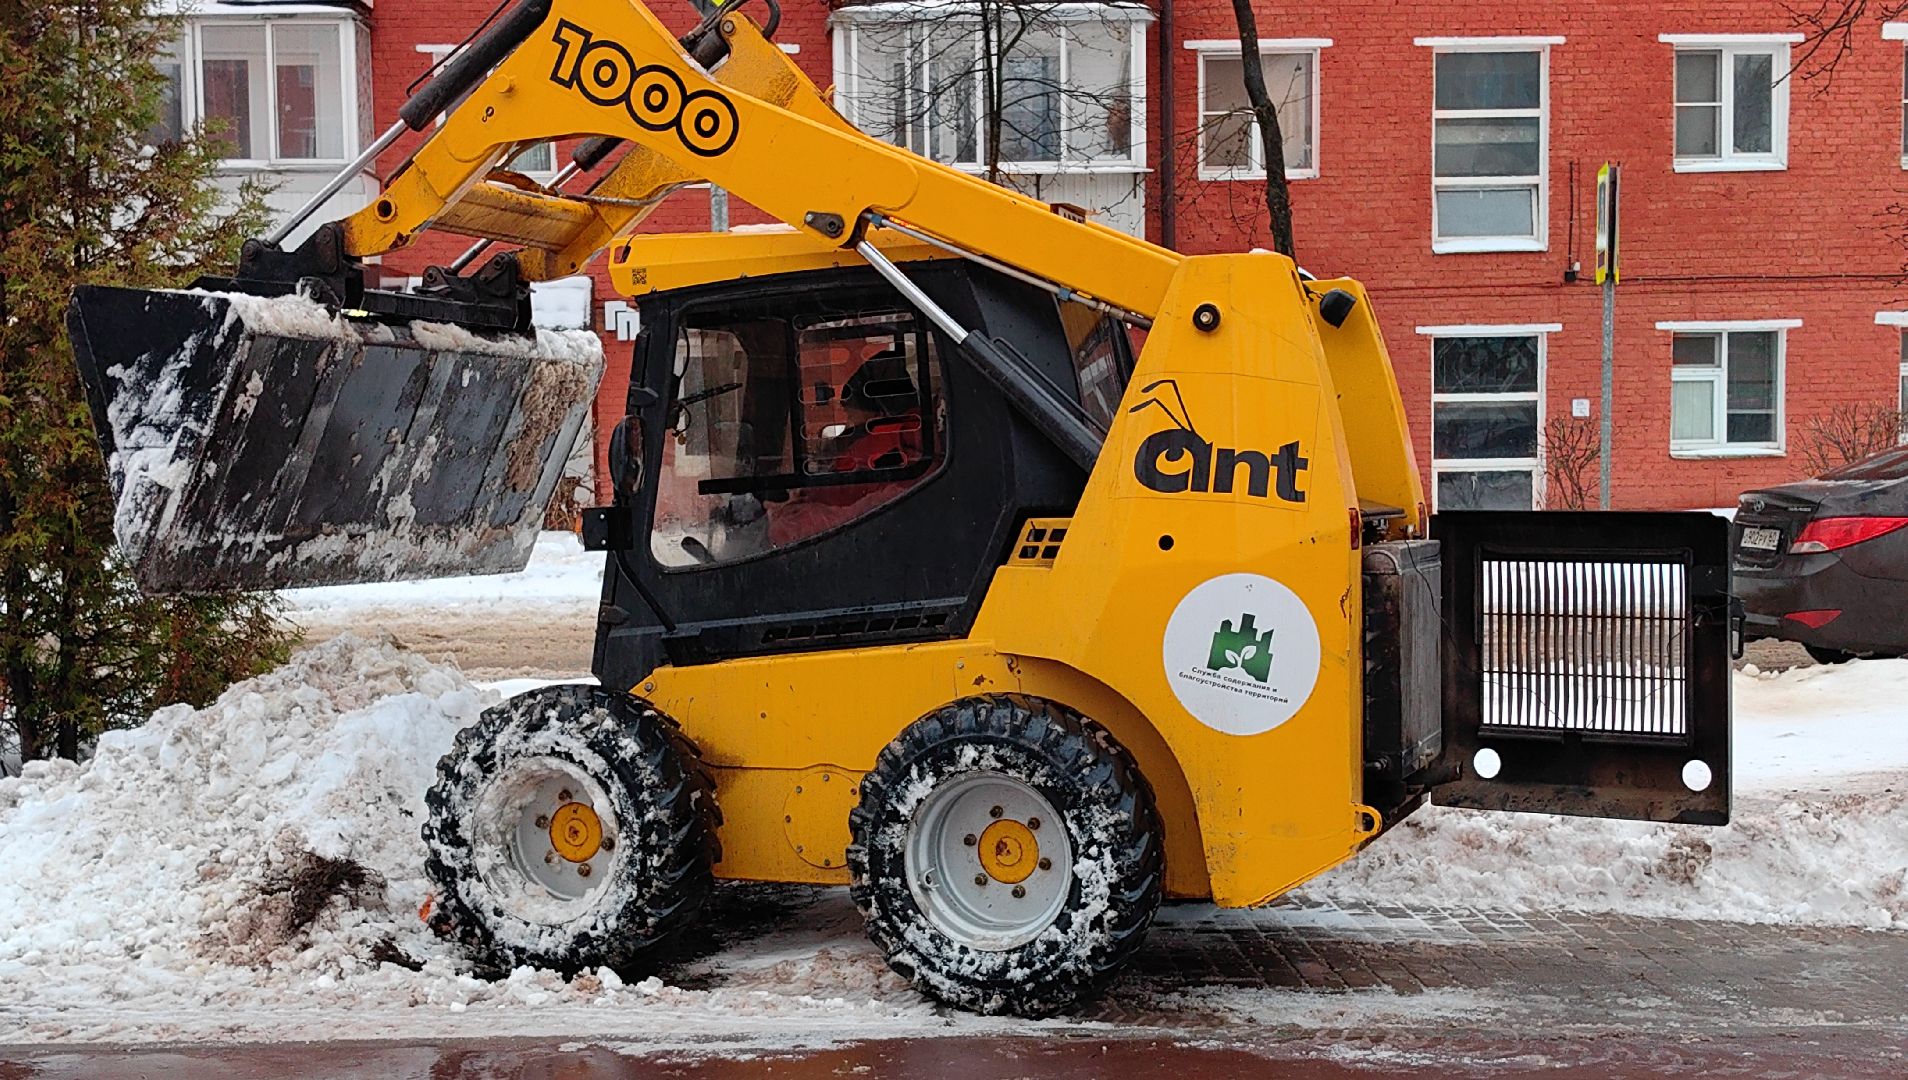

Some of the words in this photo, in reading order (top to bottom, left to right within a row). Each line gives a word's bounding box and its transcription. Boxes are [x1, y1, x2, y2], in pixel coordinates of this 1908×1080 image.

[550, 17, 740, 158] 1000
[1134, 428, 1309, 503] ant
[1178, 671, 1243, 693] благоустройства
[1244, 689, 1289, 704] территорий
[1191, 666, 1221, 679] Служба
[1223, 676, 1271, 692] содержания
